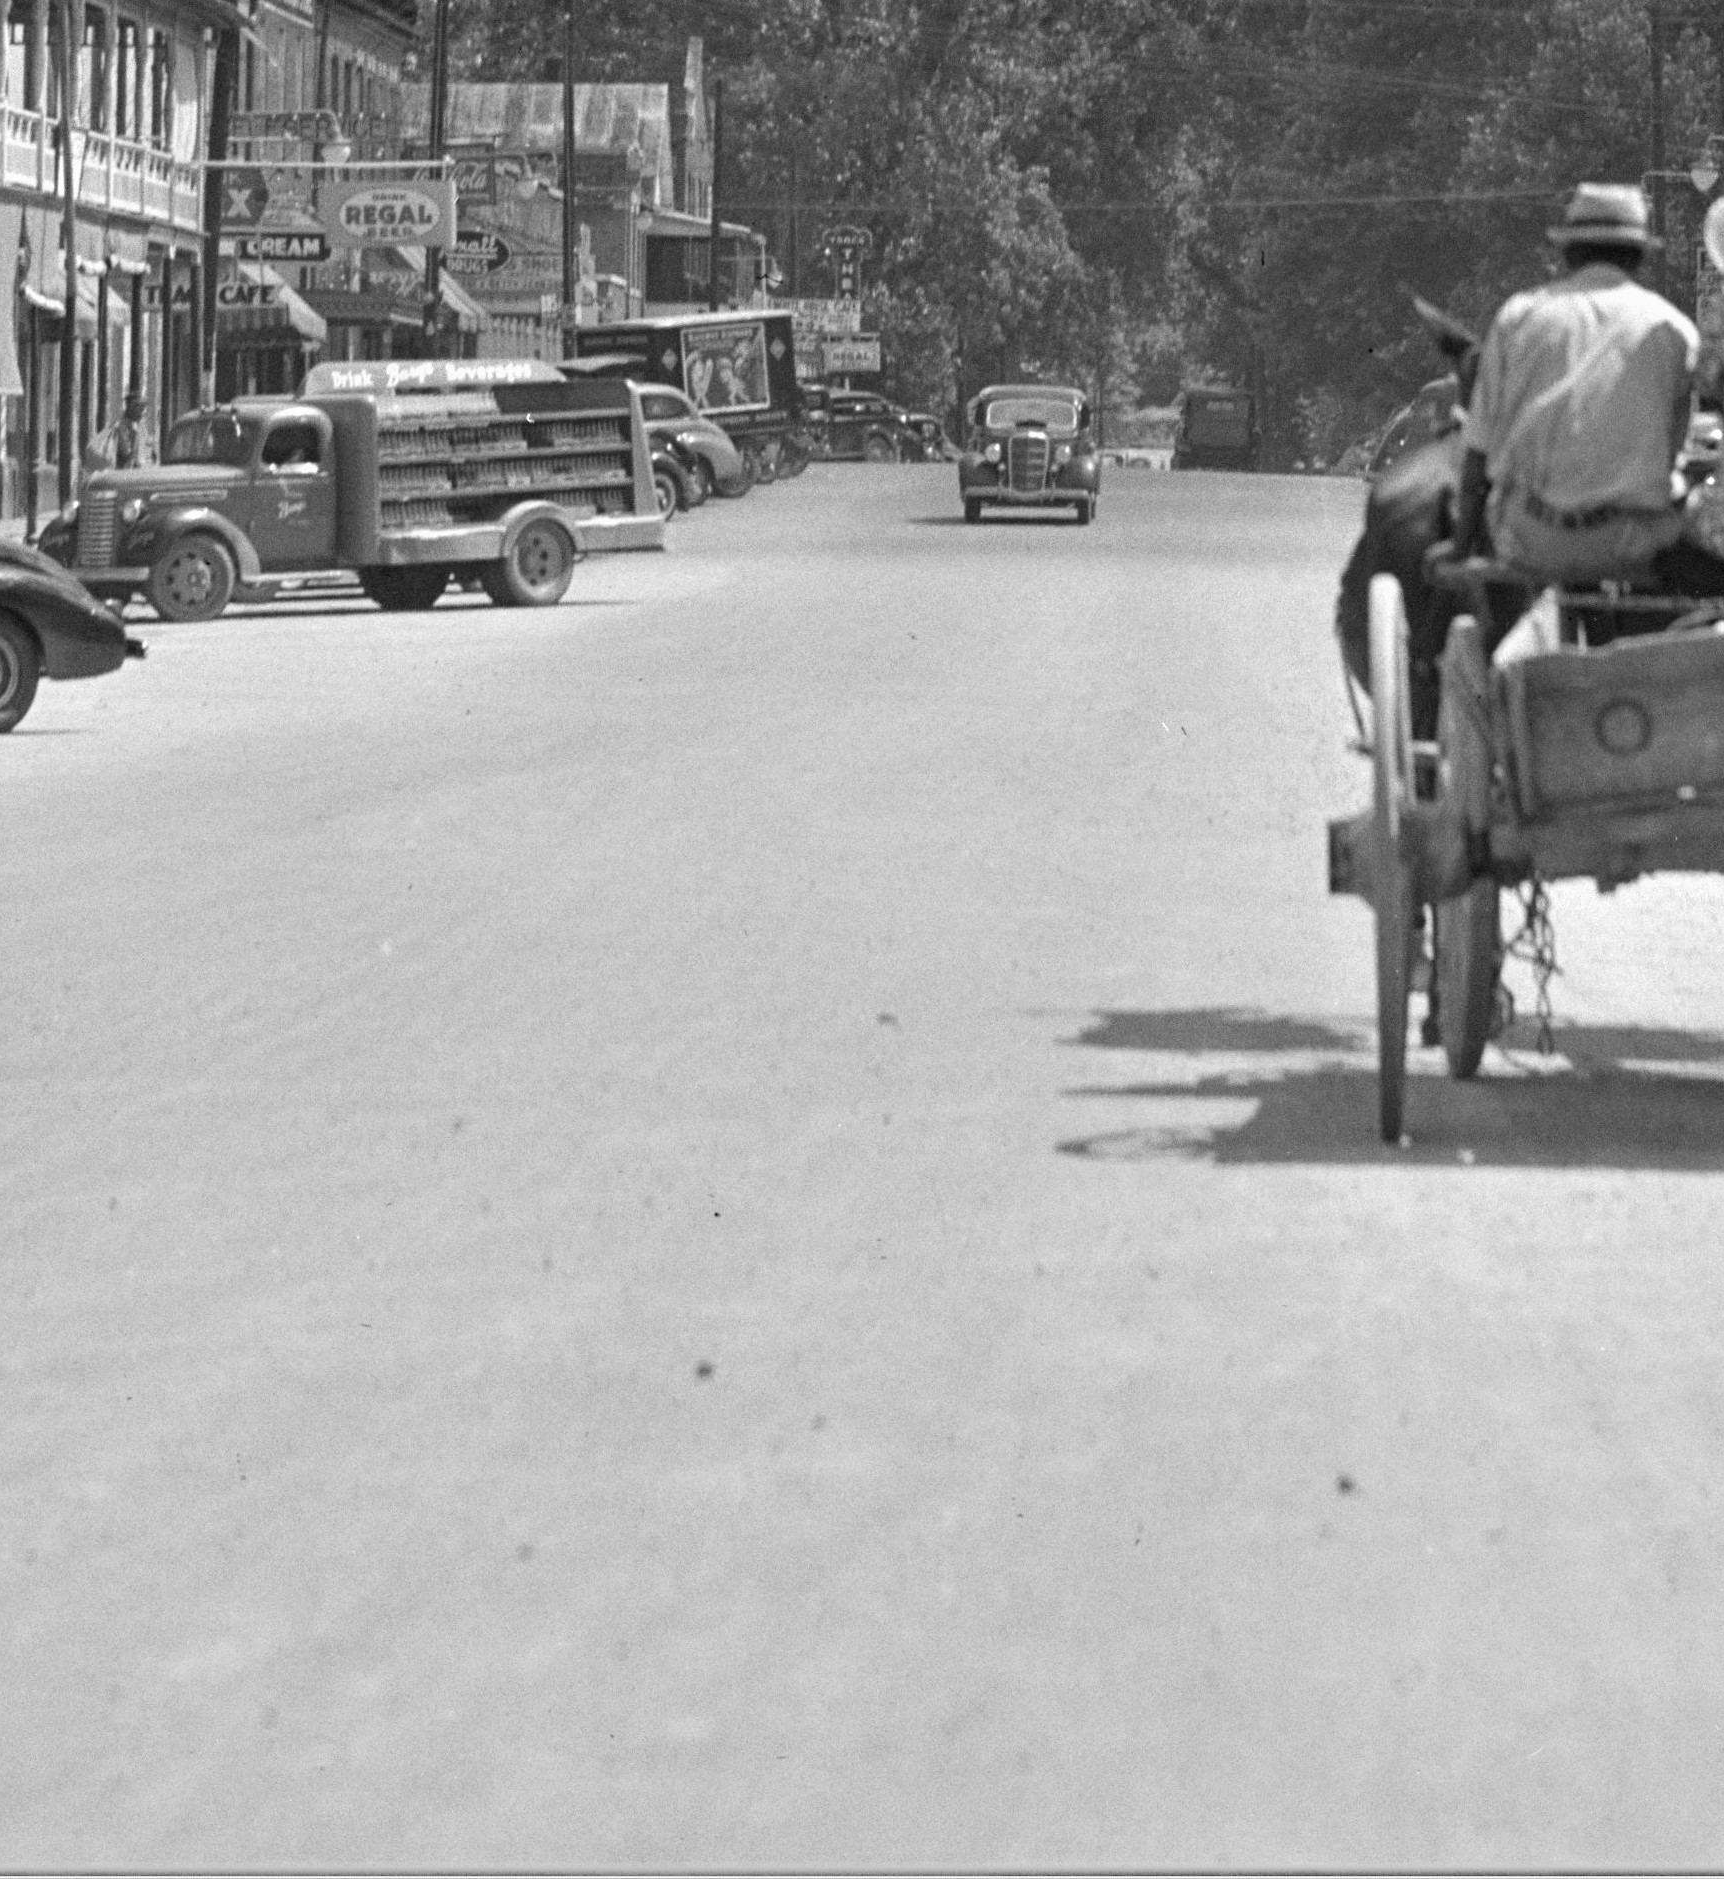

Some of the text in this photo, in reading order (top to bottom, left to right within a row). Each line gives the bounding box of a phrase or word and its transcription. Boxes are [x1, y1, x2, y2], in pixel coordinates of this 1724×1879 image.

[345, 204, 433, 226] REGAL
[247, 238, 320, 257] CREAM
[219, 284, 276, 305] CAFE
[331, 369, 374, 389] Drink
[445, 362, 533, 383] Beverages
